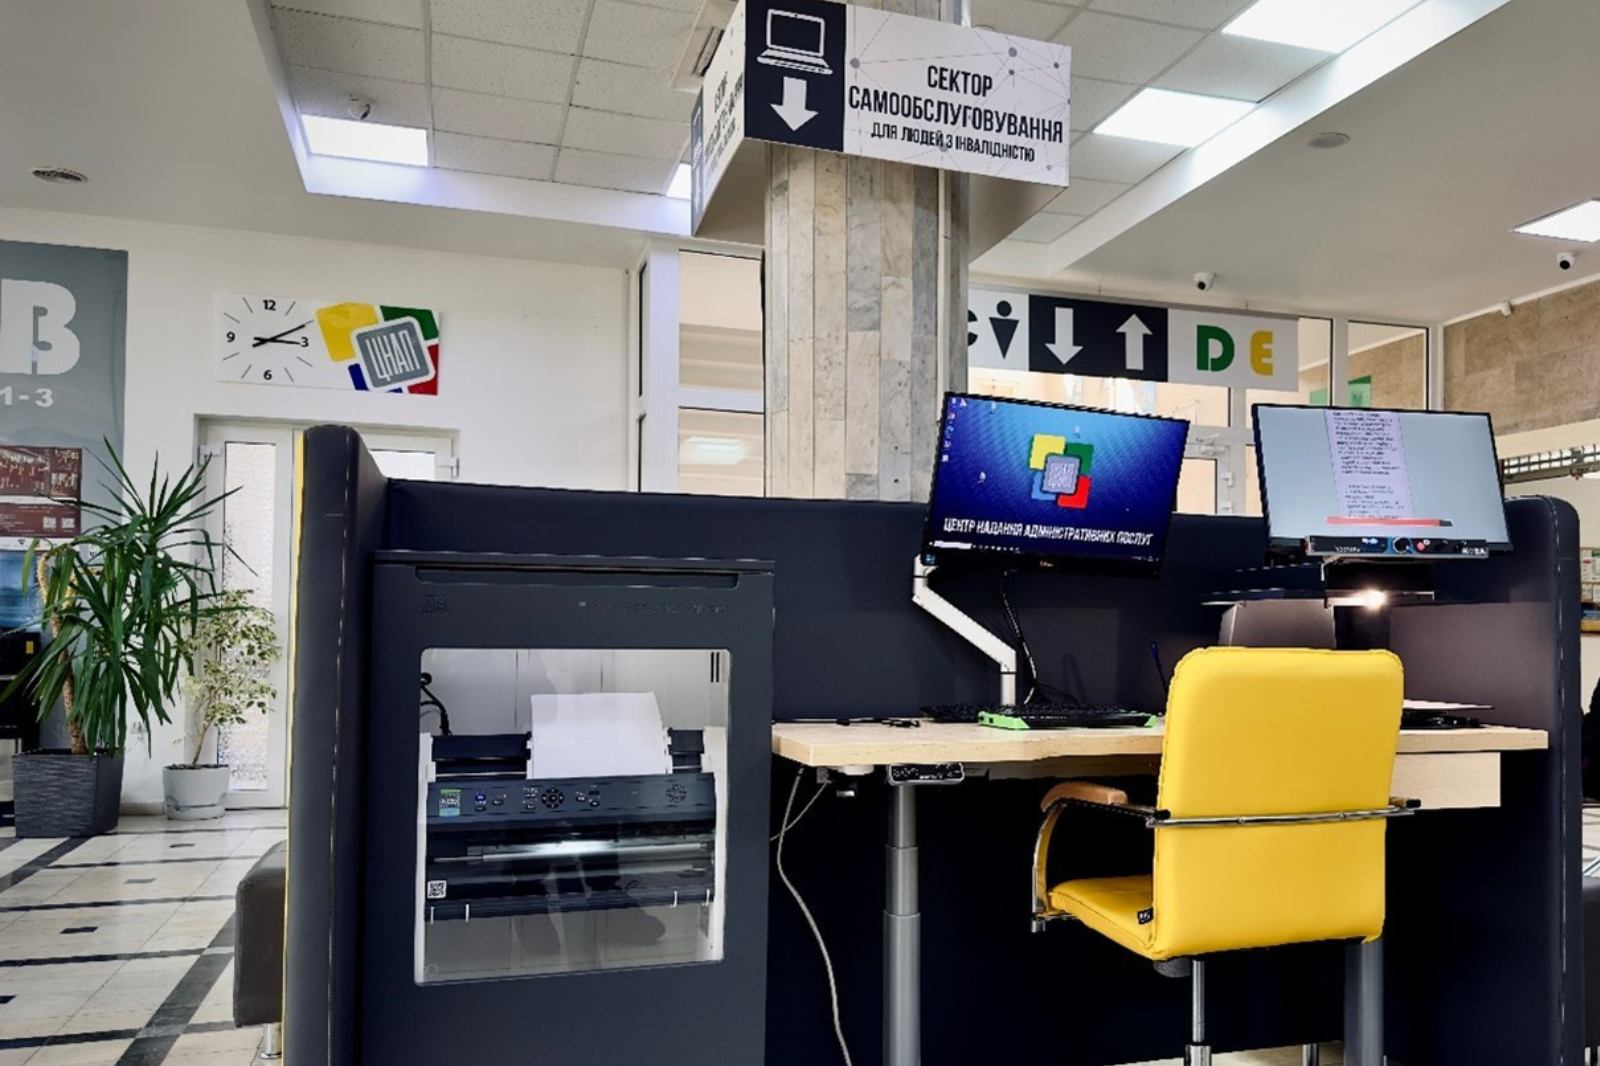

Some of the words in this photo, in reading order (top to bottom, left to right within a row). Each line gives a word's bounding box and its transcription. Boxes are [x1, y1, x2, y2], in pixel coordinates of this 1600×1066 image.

[927, 65, 993, 97] СЕКТОР
[848, 85, 1064, 143] САМООБСЛУГОВУВАННЯ
[871, 122, 897, 140] ДЛЯ
[901, 126, 943, 147] ЛЮДЕЙ
[955, 135, 1036, 162] ІНВАЛІДНІСТЮ
[263, 299, 276, 311] 12
[226, 331, 236, 343] 9
[301, 336, 309, 348] 3
[365, 329, 421, 382] ЦНАП
[1196, 325, 1235, 372] D
[1250, 331, 1274, 376] E
[263, 369, 272, 381] 6
[943, 517, 975, 533] ЦЕНТР
